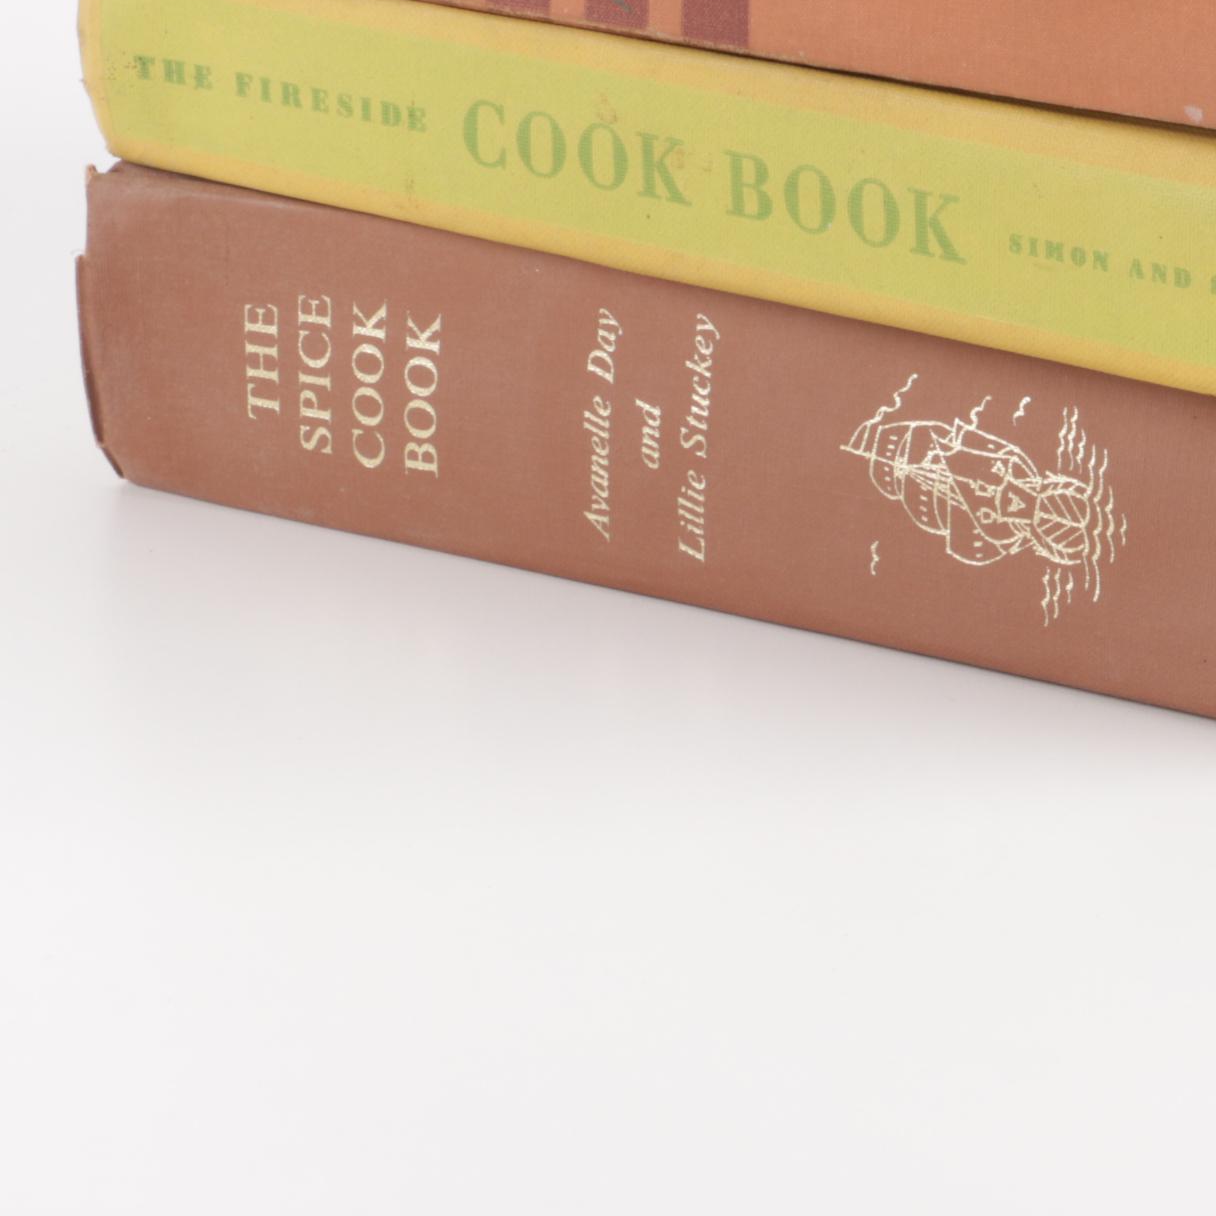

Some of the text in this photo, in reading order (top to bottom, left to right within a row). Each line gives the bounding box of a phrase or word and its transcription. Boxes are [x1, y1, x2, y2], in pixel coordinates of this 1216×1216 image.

[133, 55, 214, 91] THE
[234, 71, 428, 134] FIRESIDE
[462, 99, 693, 207] COOK
[722, 150, 967, 264] BOOK
[1008, 233, 1109, 273] SIMON
[1129, 258, 1192, 289] AND
[244, 303, 281, 420] THE
[298, 295, 332, 455] SPICE
[352, 299, 388, 469] COOK
[404, 311, 442, 479] BOOK
[583, 307, 624, 543] Avanelle Day
[634, 398, 662, 470] and
[678, 313, 721, 563] Lillie Stuckey
